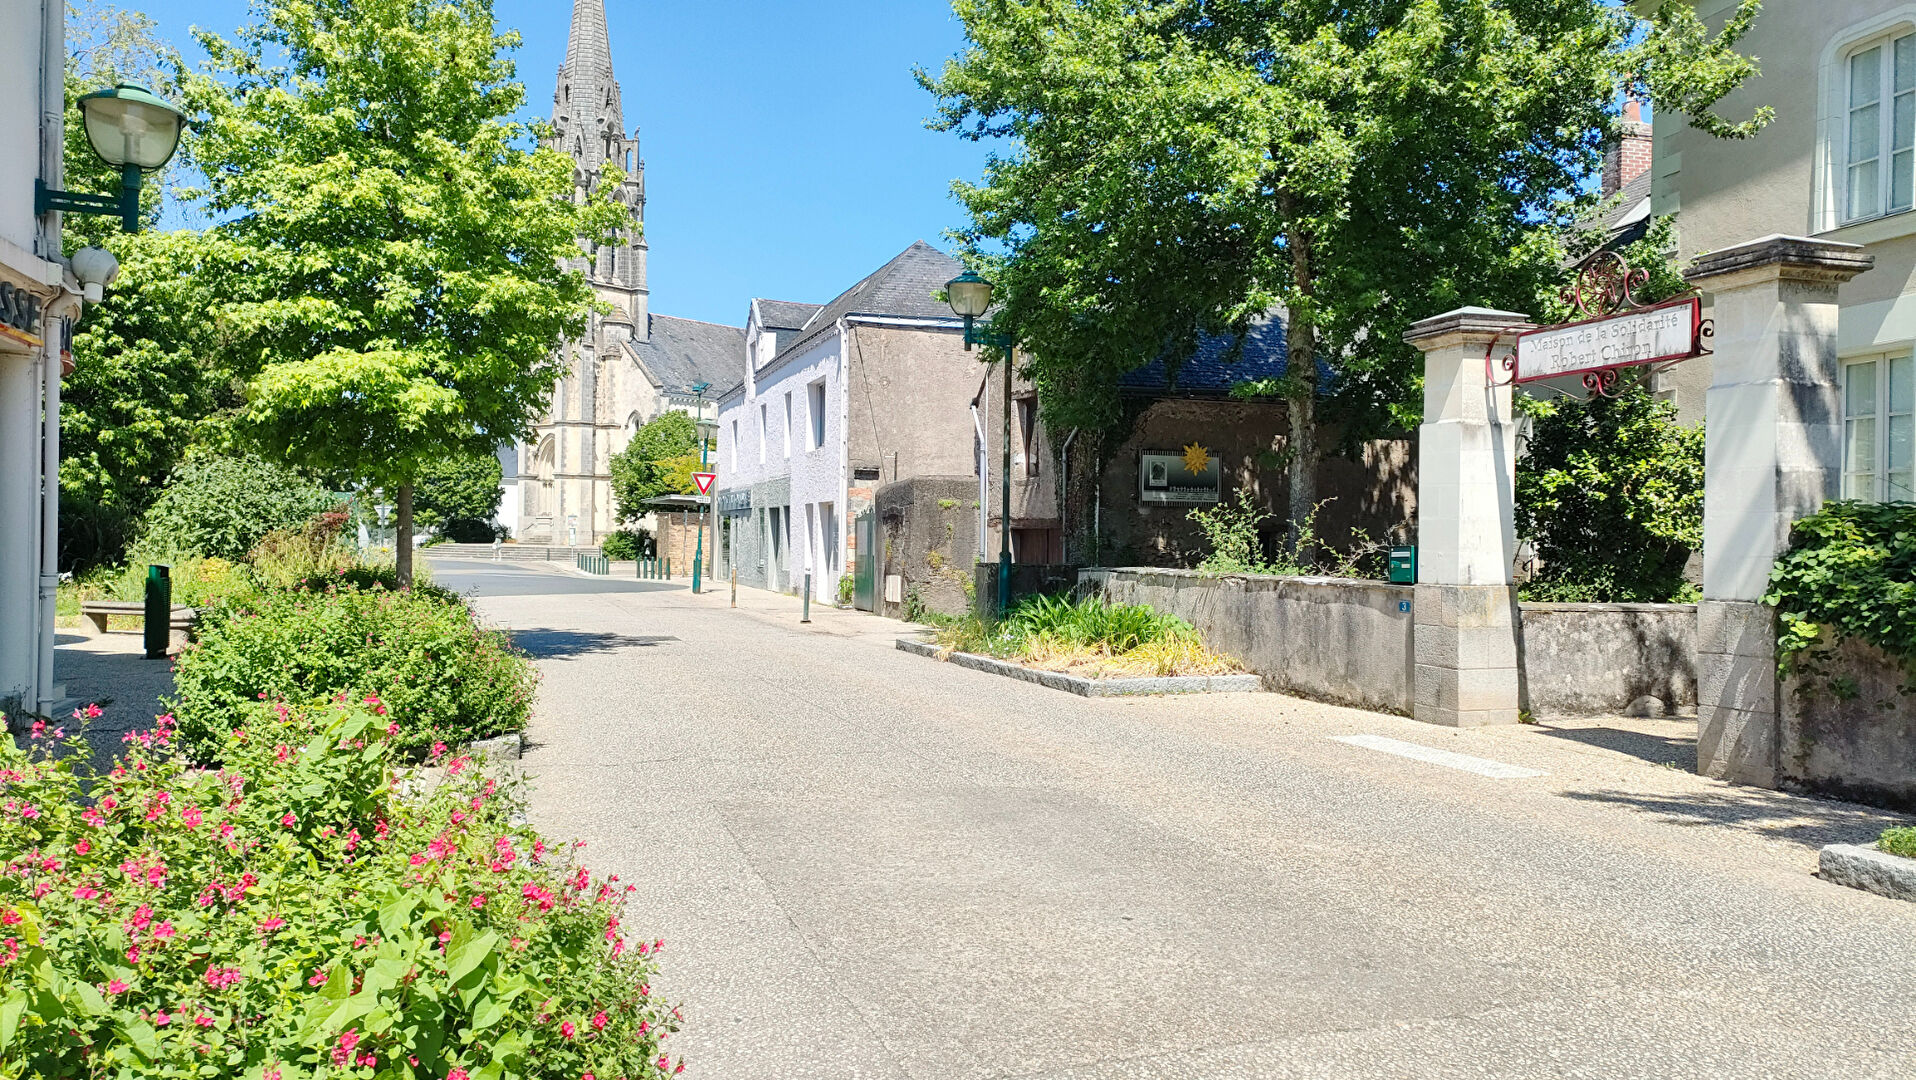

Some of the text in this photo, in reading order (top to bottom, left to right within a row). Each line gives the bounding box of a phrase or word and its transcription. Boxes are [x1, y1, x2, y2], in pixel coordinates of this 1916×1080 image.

[1531, 314, 1678, 353] Maison de la Solidarité
[1550, 341, 1651, 369] Robert Chiron
